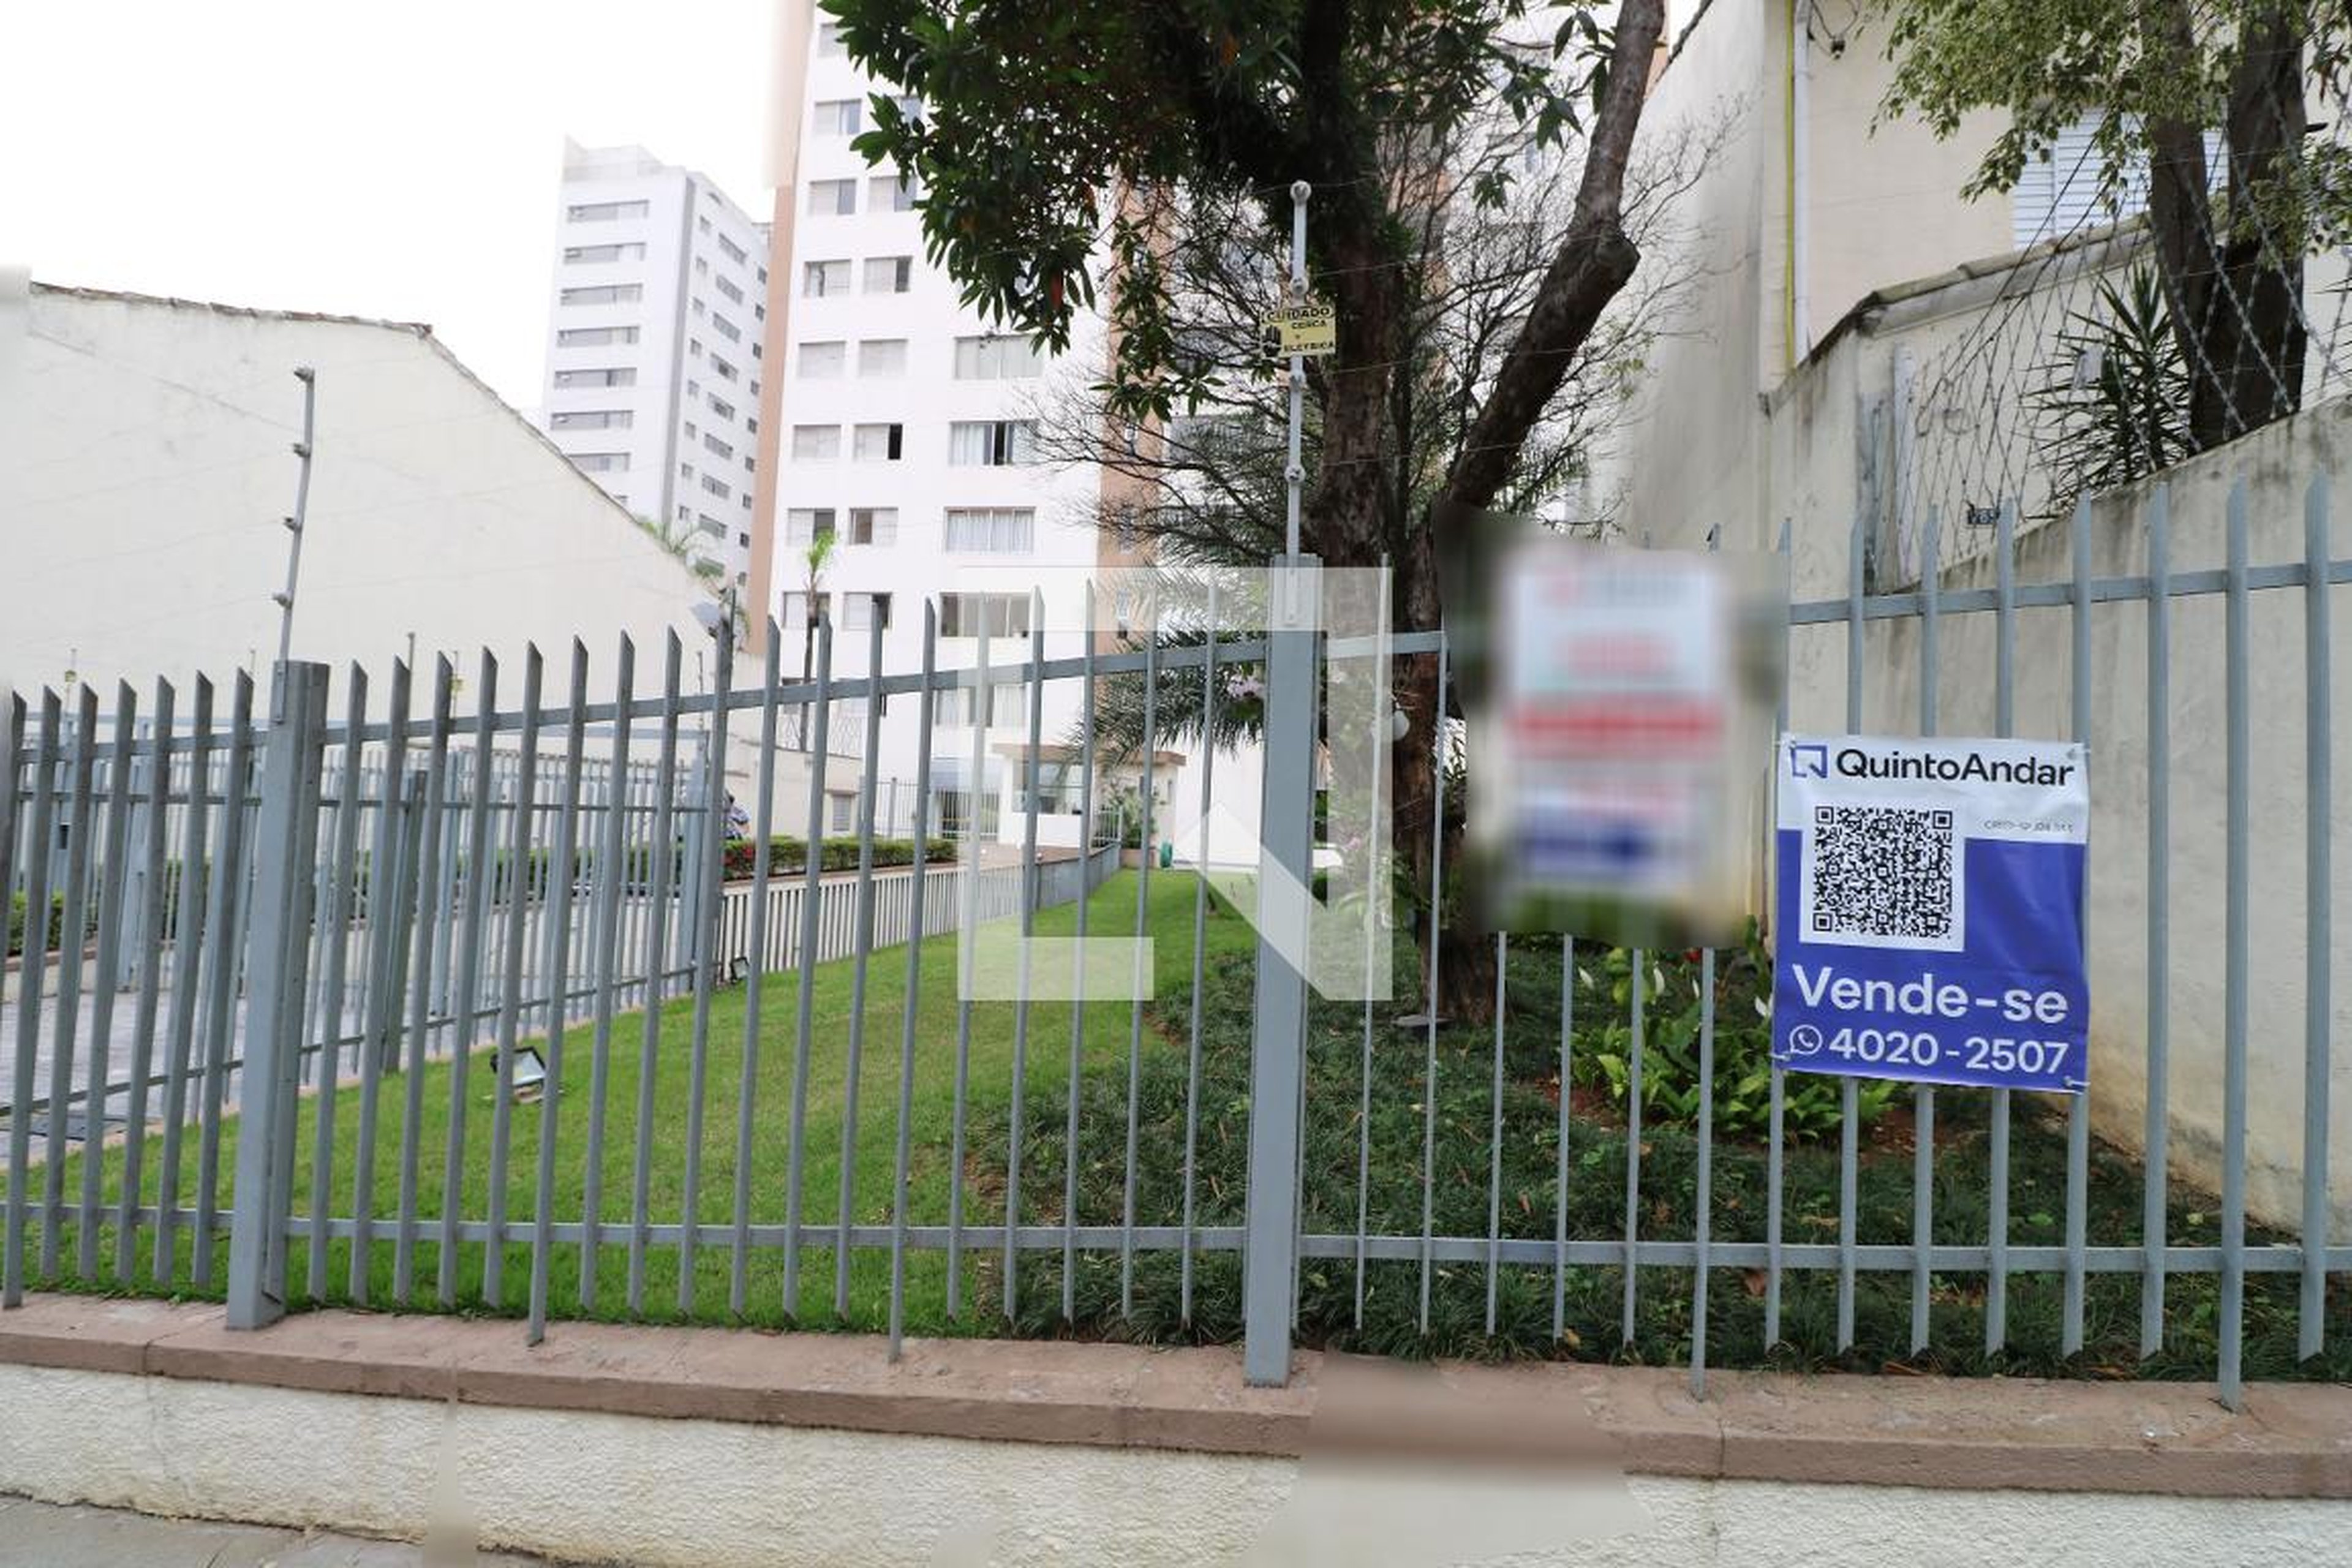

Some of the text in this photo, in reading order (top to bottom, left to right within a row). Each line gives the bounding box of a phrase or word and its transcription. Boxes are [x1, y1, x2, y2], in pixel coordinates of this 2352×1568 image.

[1267, 307, 1330, 320] CUIDADO
[1836, 748, 2075, 786] QuintoAndar
[1792, 964, 2069, 1023] Vende-se
[1829, 1028, 2070, 1074] 4020-2507
